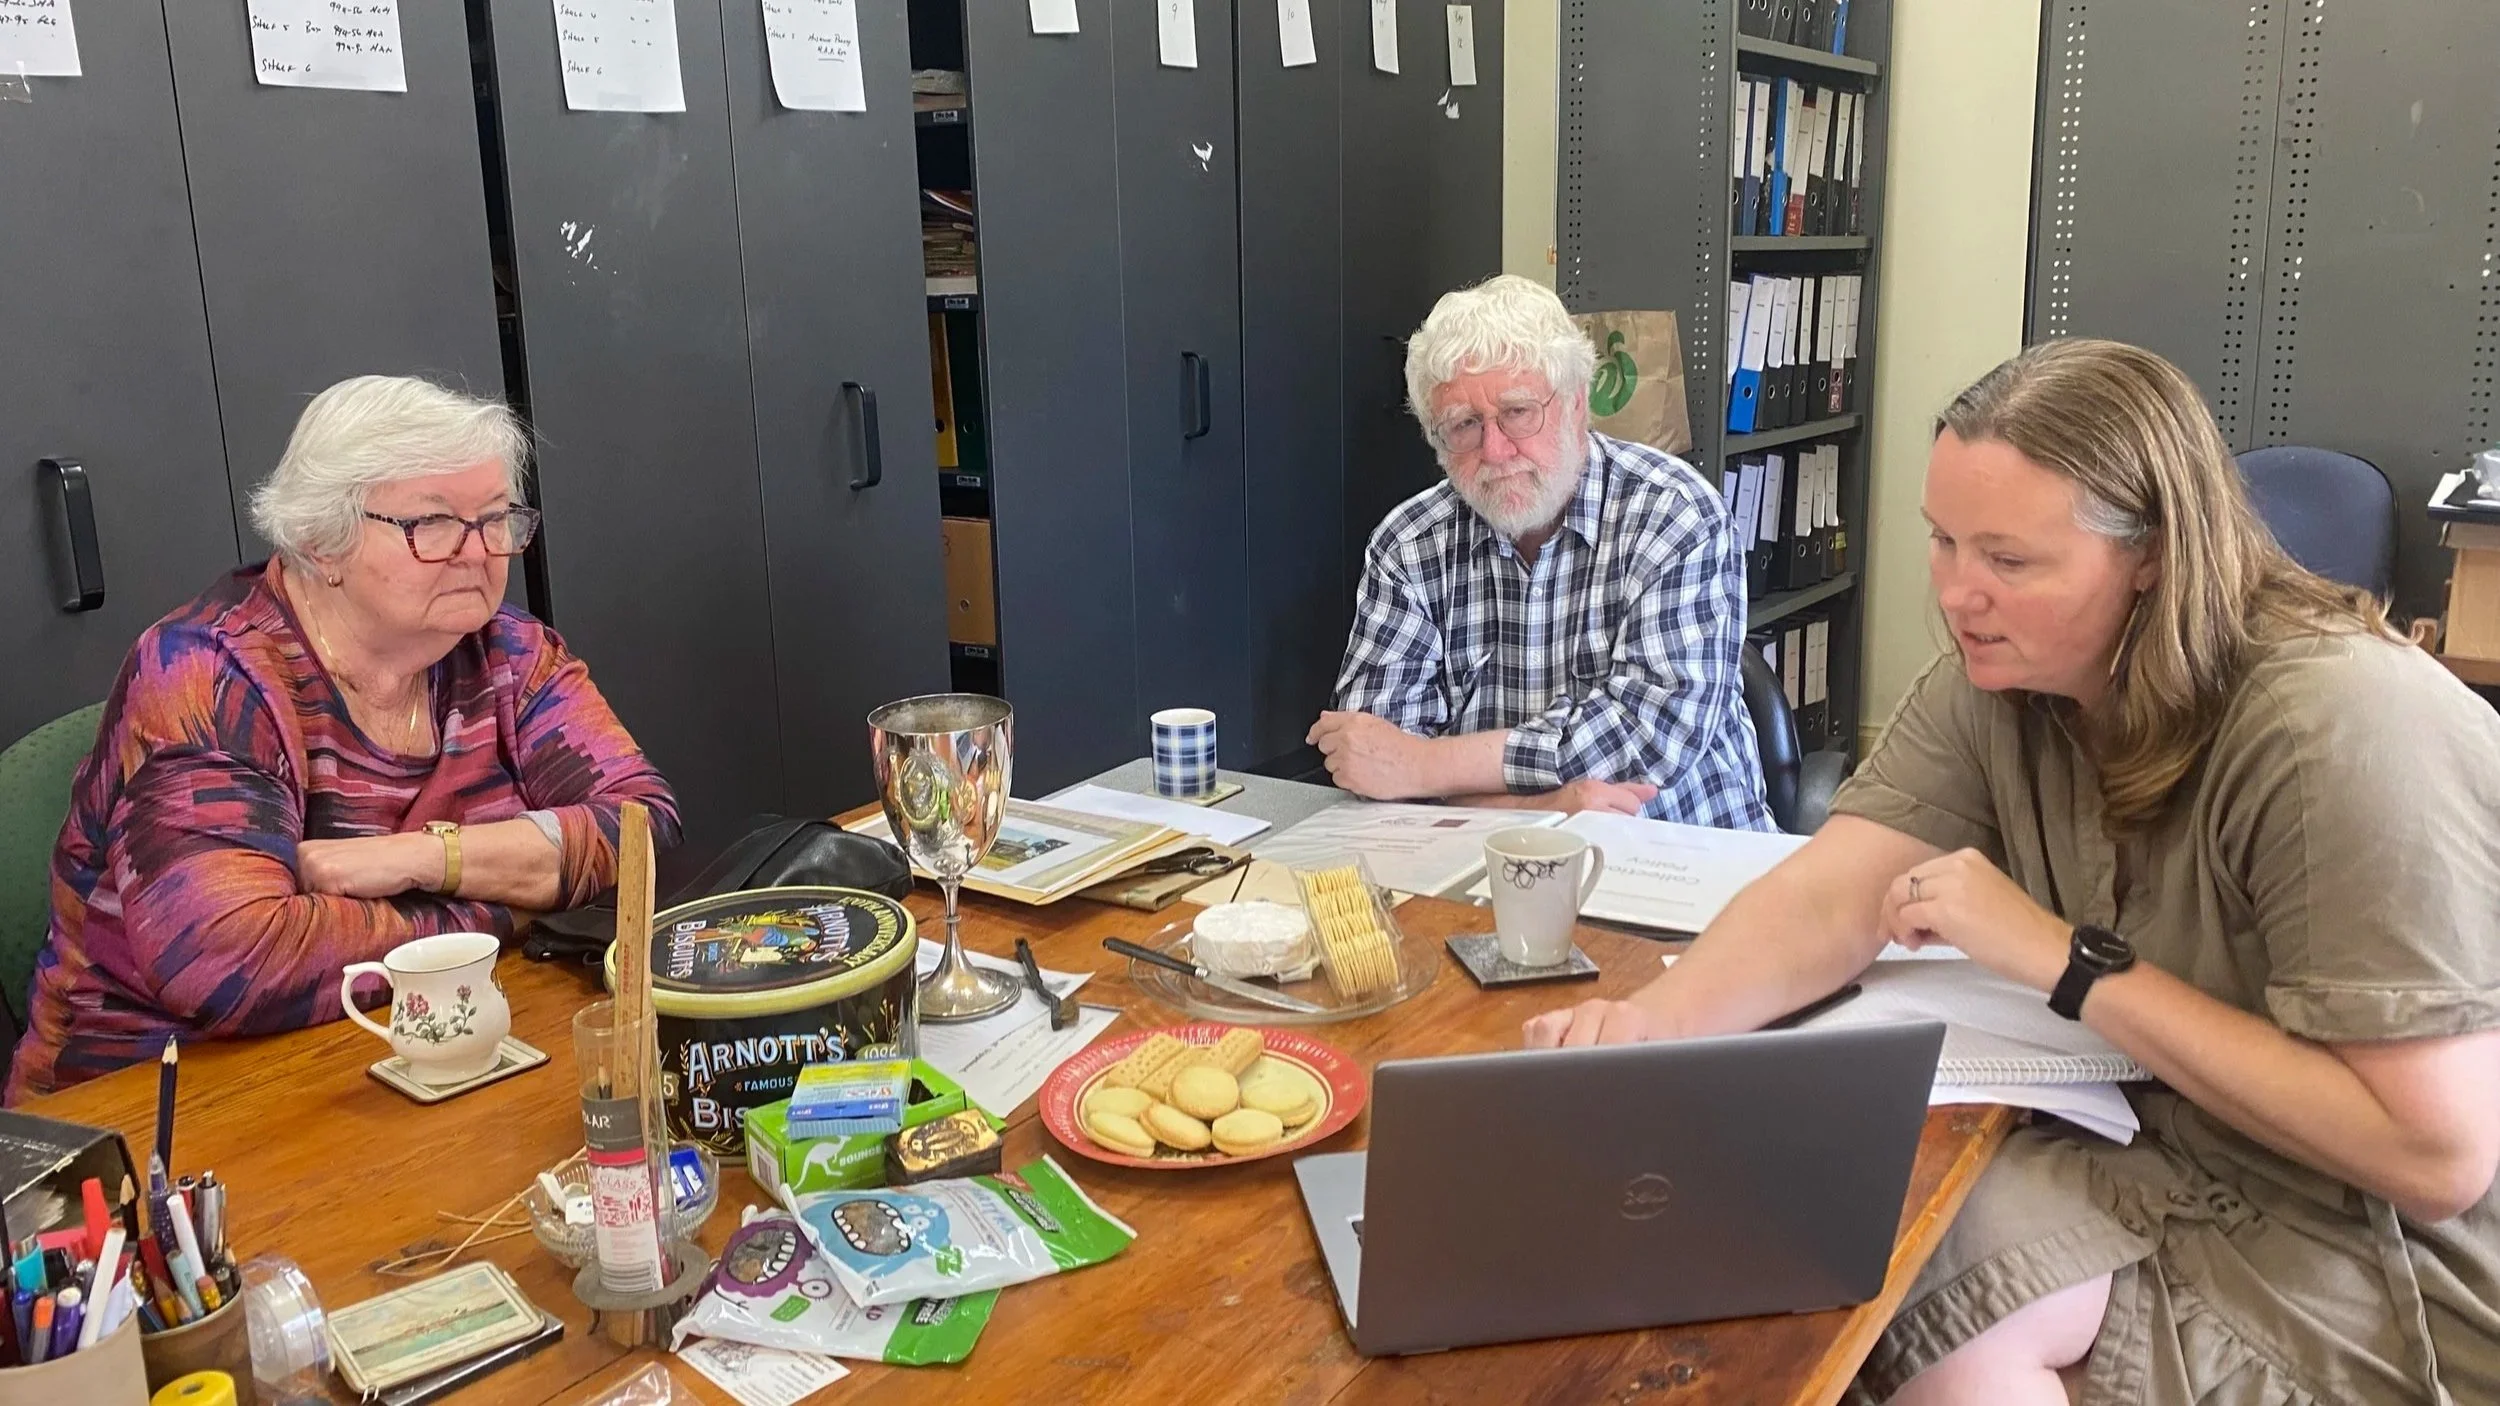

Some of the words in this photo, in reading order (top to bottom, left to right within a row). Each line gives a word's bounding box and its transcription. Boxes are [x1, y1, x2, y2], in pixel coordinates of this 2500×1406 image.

[1171, 3, 1178, 22] 9
[1603, 864, 1700, 887] Collectio
[1624, 856, 1688, 873] Policy
[799, 905, 851, 962] ARNOTT'S
[671, 920, 706, 977] BISCUITS
[687, 1030, 847, 1092] ARNOTT'S
[744, 1076, 794, 1093] FAMOUS
[693, 1097, 745, 1130] BIS
